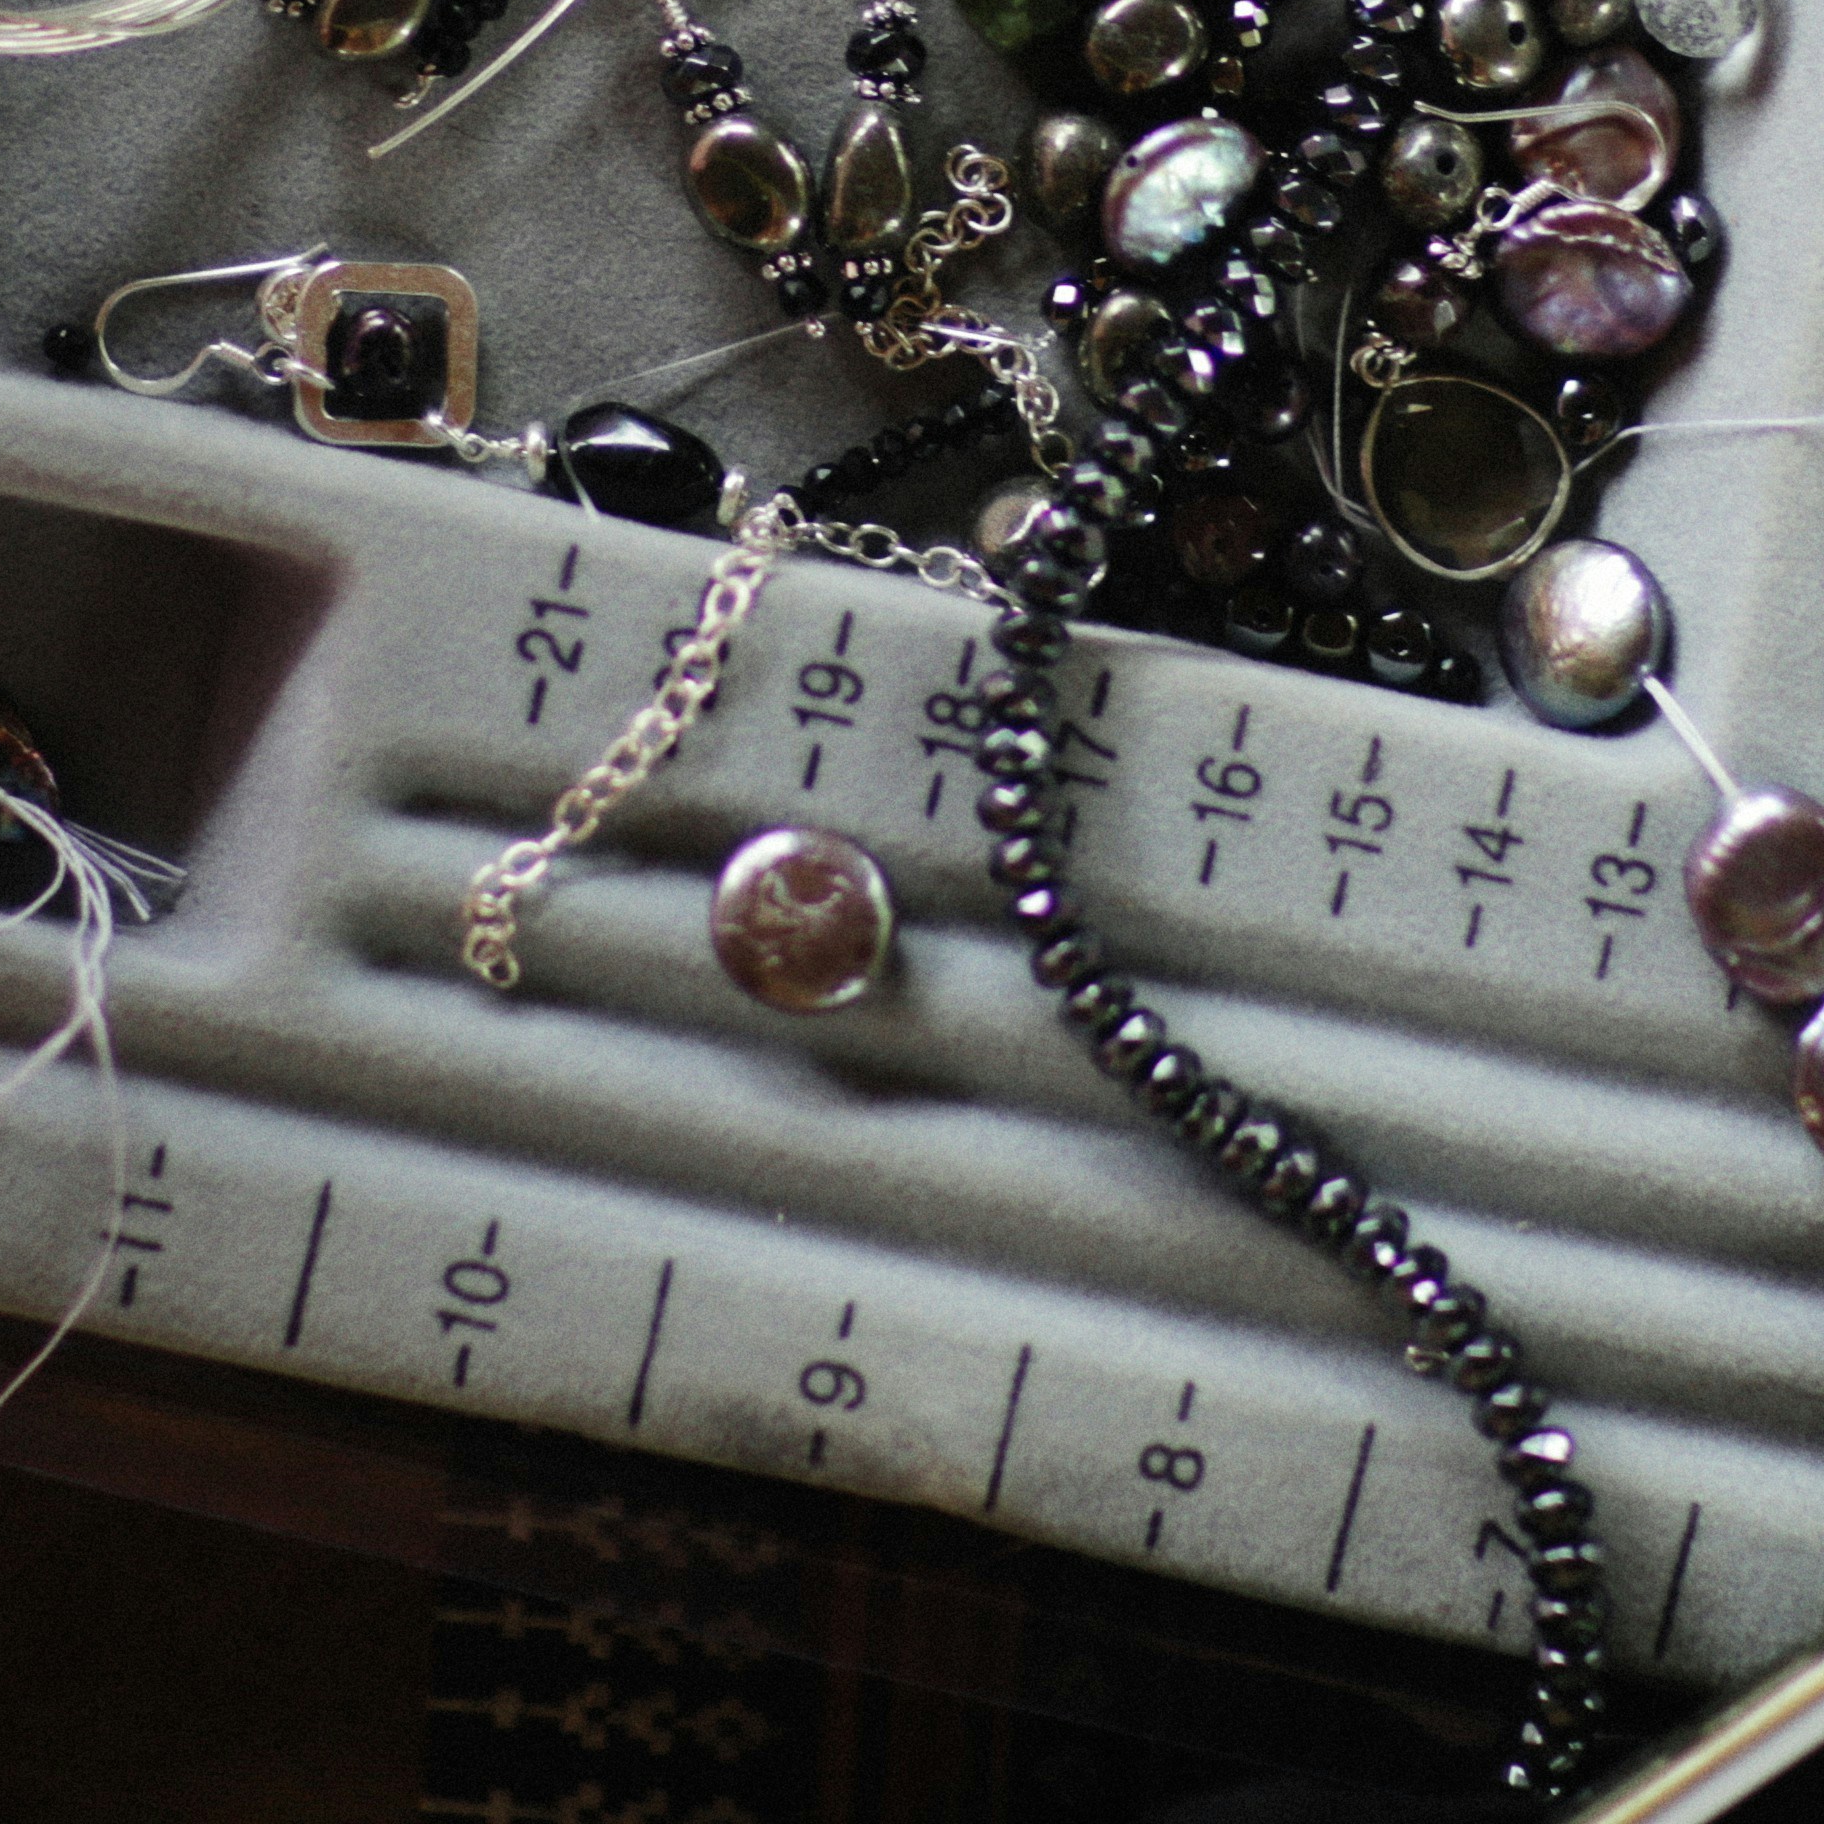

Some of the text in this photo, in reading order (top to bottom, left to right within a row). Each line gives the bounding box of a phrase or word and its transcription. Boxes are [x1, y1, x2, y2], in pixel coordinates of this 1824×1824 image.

[514, 598, 589, 675] 21
[791, 660, 866, 728] 19
[916, 692, 985, 758] 18
[1190, 755, 1264, 823] 16
[1324, 789, 1396, 856] 15
[1453, 824, 1524, 887] 14
[1584, 853, 1659, 919] 13
[98, 1192, 174, 1254] 11
[434, 1259, 512, 1335] 10
[797, 1359, 868, 1413] 9
[1136, 1442, 1206, 1495] 8
